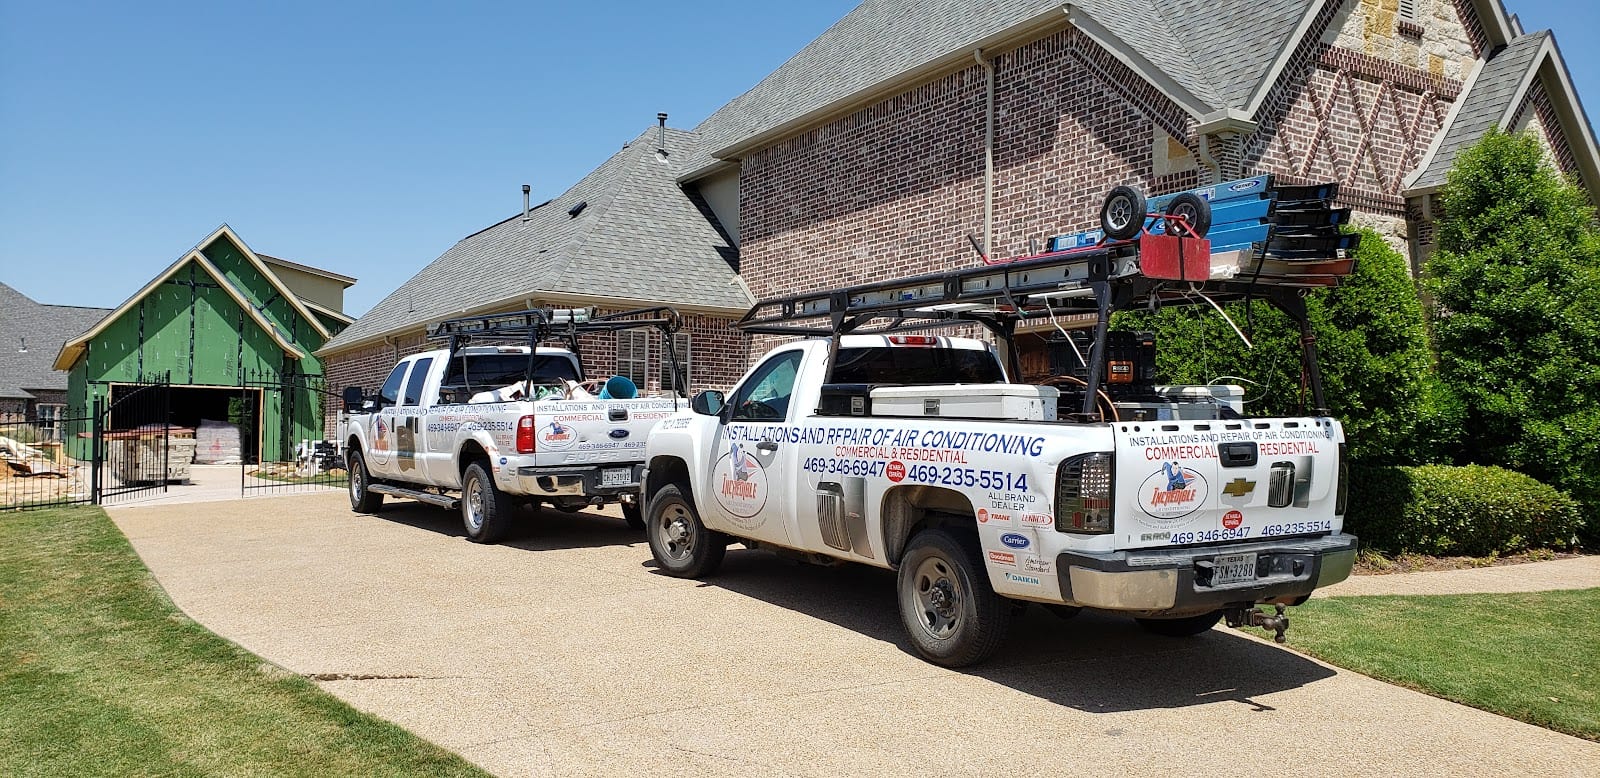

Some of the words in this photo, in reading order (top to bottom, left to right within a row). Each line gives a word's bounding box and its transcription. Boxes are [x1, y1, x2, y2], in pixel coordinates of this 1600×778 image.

[536, 404, 587, 412] INSTALLATIONS
[553, 414, 605, 422] COMMERCIAL
[722, 425, 800, 444] INSTALLATIONS
[800, 427, 825, 444] AND
[872, 428, 895, 446] OF
[894, 429, 919, 447] AIR
[921, 430, 1046, 457] CONDITIONING
[1129, 434, 1199, 447] INSTALLATIONS
[1200, 433, 1219, 442] AND
[1220, 432, 1251, 441] REPAIR
[1252, 431, 1263, 440] OF
[1265, 431, 1277, 440] AIR
[1279, 430, 1330, 440] CONDITIONING
[835, 445, 889, 459] COMMERCIAL
[891, 448, 898, 459] &
[900, 448, 968, 464] RESIDENTIAL
[1145, 445, 1218, 460] COMMERCIAL
[1260, 441, 1320, 456] RESIDENTIAL
[804, 457, 886, 478] 469-346-6947
[908, 464, 1028, 493] 469-235-5514
[988, 491, 1005, 501] ALL
[1005, 493, 1036, 503] BRAND
[991, 501, 1025, 512] DEALER
[991, 513, 1011, 521] TRANE
[1021, 513, 1046, 524] LENNOX
[1261, 520, 1331, 536] 469-235-5514
[1004, 535, 1026, 545] Carrier
[1012, 574, 1039, 584] DAIKIN
